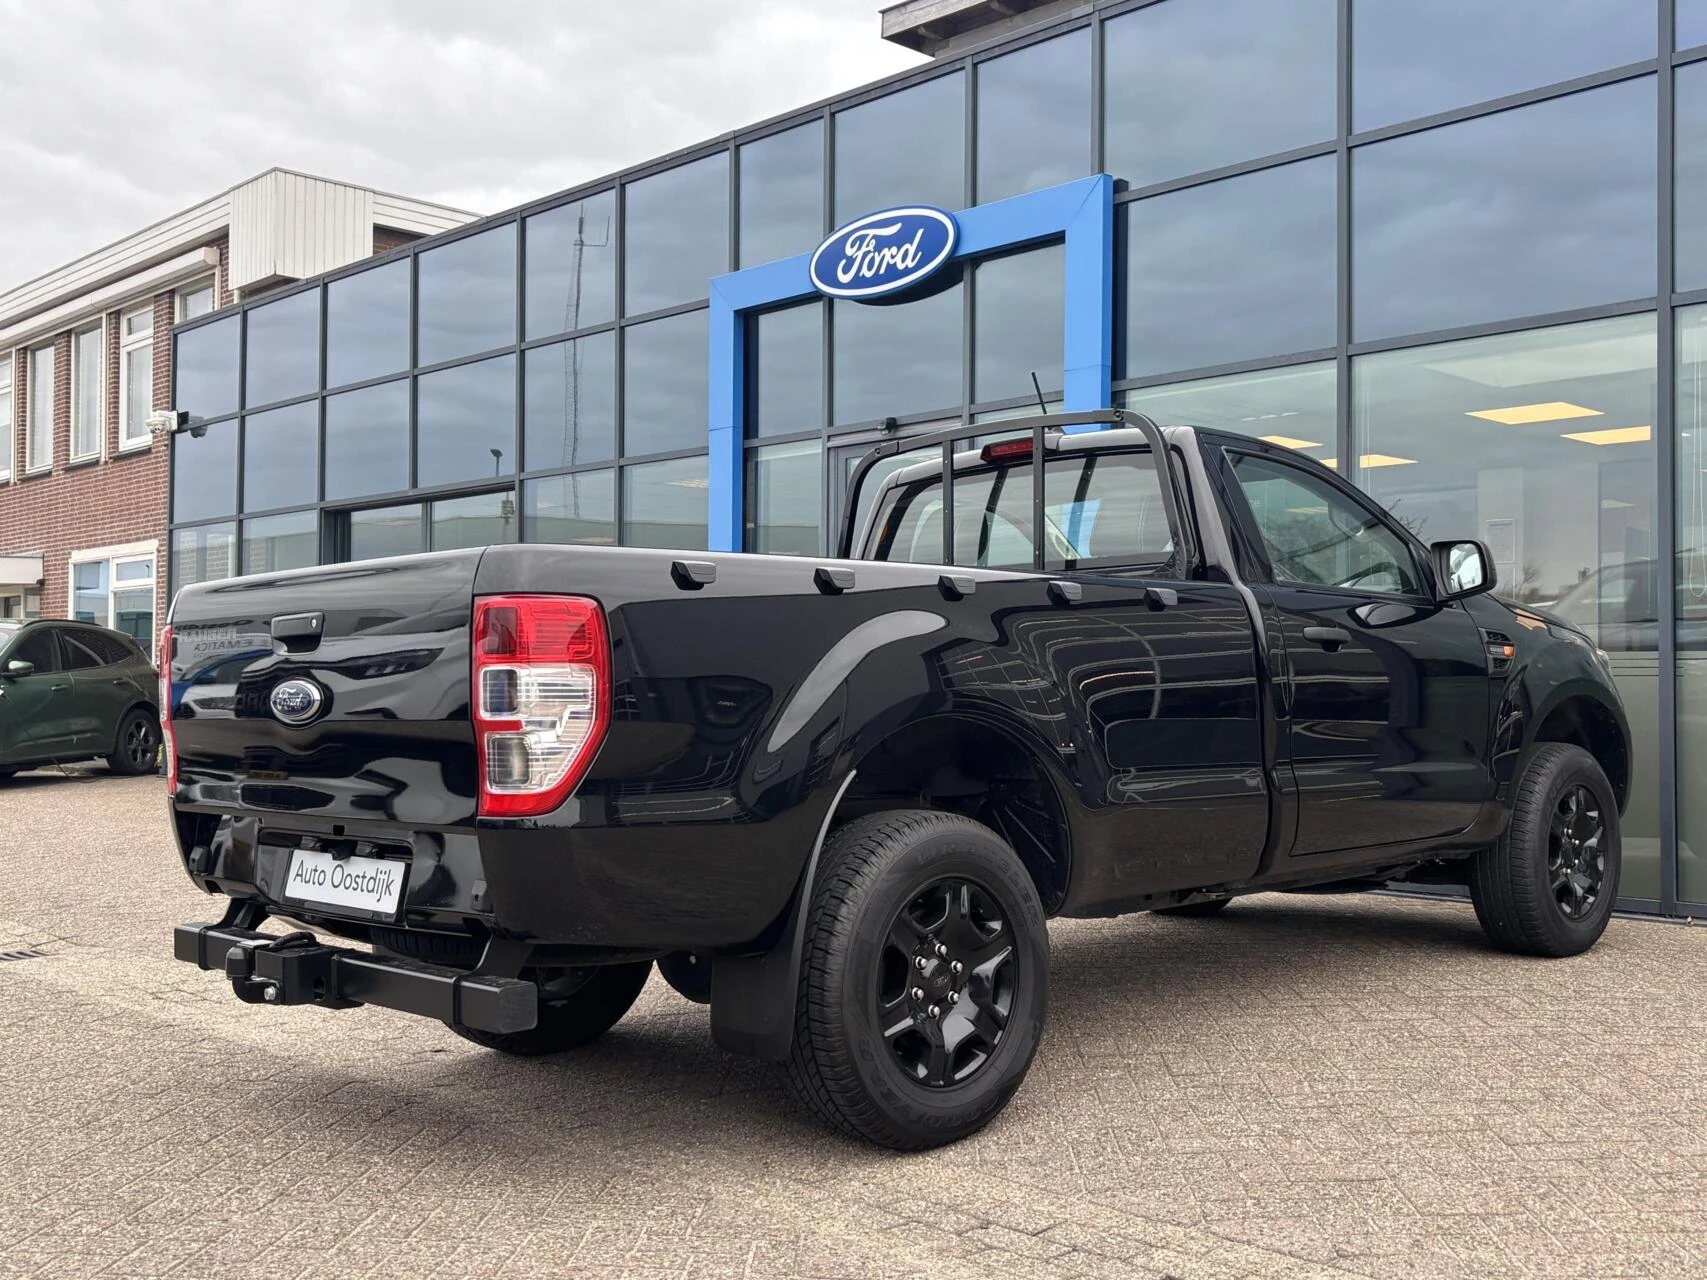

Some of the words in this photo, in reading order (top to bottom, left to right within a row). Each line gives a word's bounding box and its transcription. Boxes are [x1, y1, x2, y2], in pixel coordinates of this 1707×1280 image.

[836, 222, 925, 284] Ford
[276, 687, 304, 711] Ford
[292, 859, 327, 887] Auto
[330, 863, 396, 903] Oostdijk
